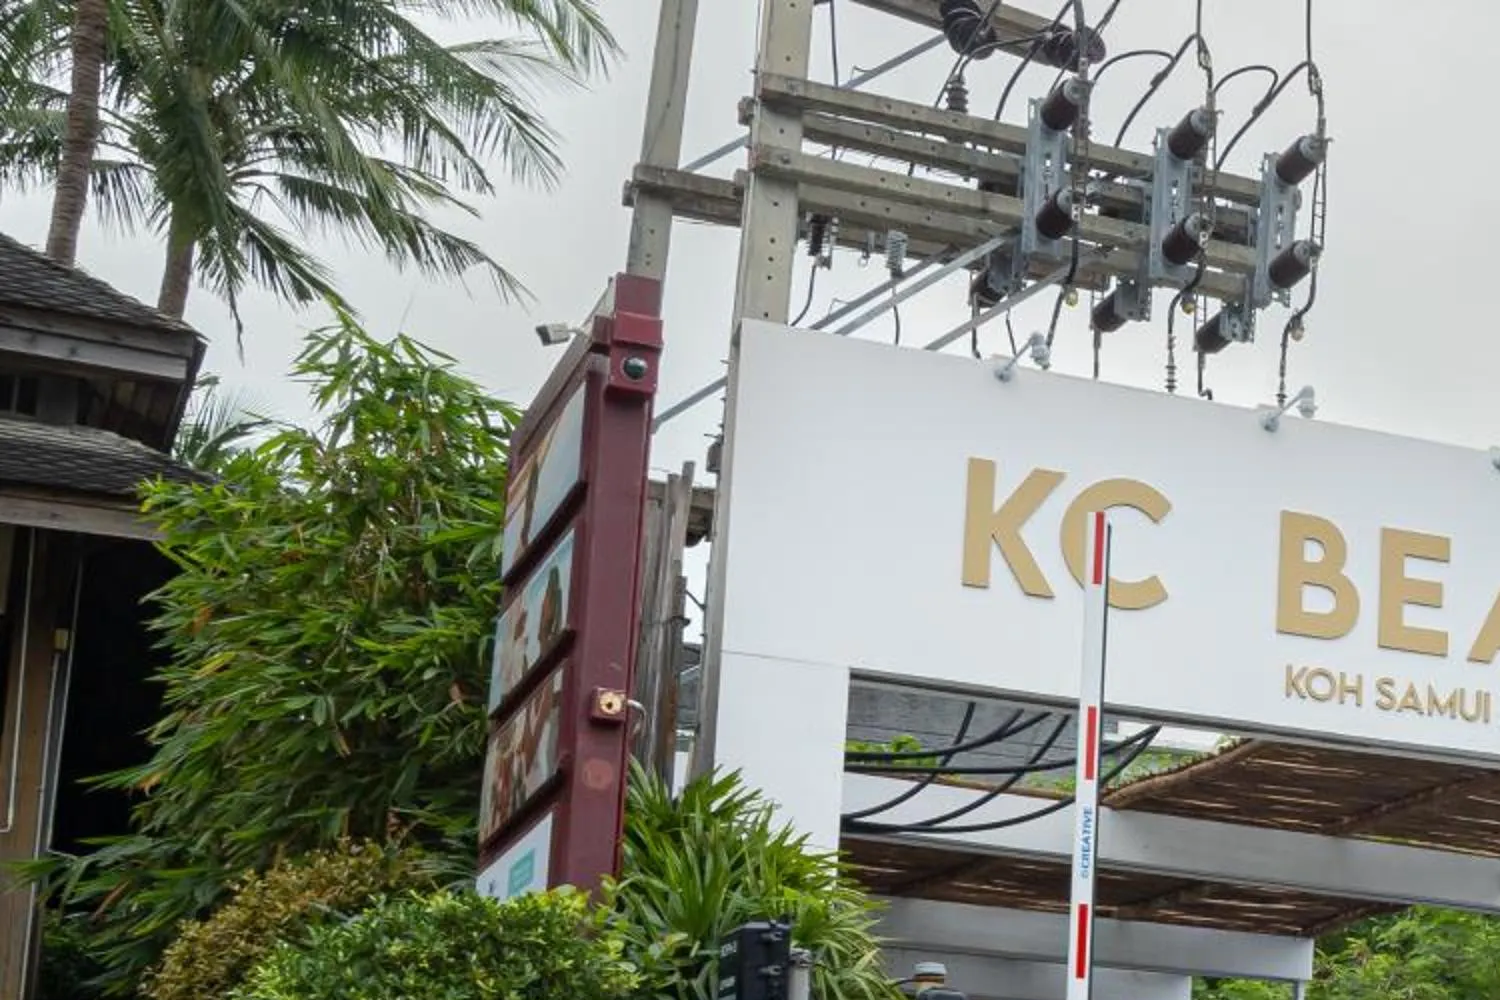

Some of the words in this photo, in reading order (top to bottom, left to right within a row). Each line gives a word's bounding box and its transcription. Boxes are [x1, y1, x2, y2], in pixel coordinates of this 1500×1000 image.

[962, 457, 1173, 611] KC
[1285, 664, 1363, 707] KOH
[1375, 676, 1491, 723] SAMUI
